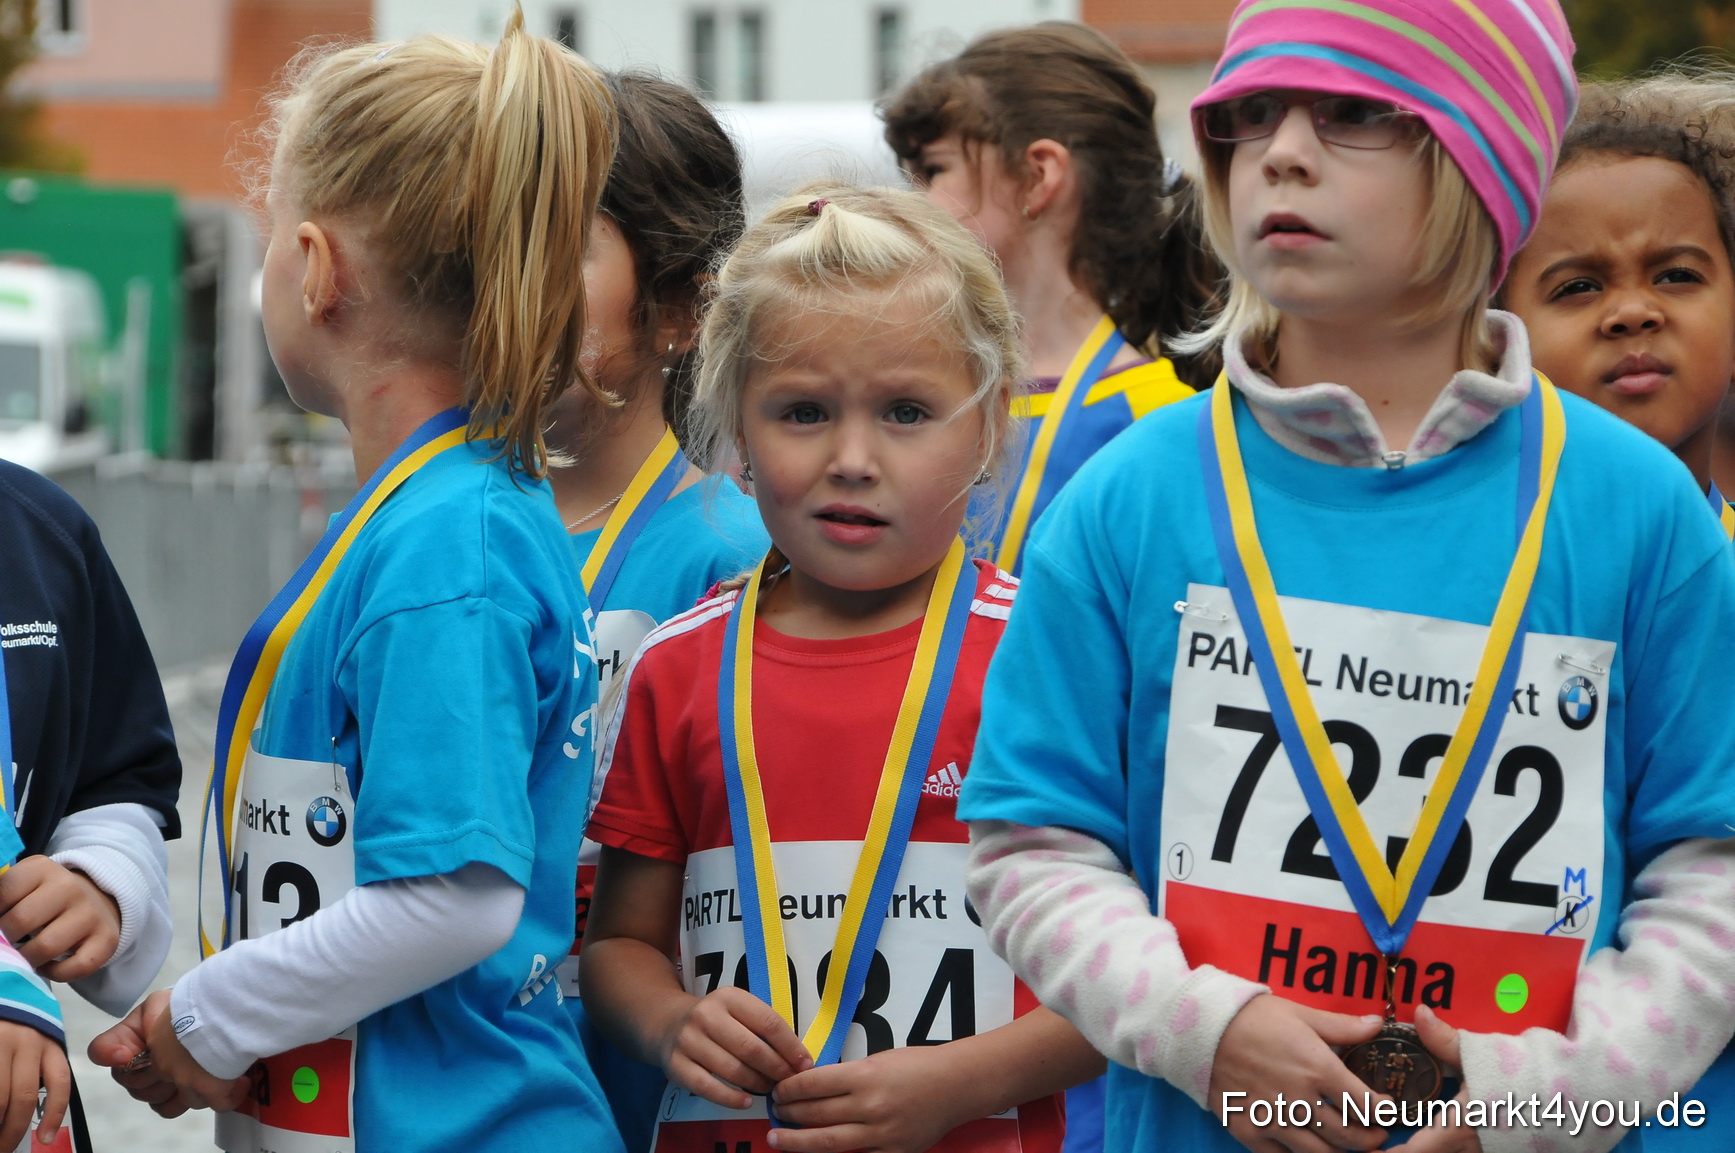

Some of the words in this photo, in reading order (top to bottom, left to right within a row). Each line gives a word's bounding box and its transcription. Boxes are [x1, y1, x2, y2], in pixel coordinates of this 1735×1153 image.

[0, 621, 57, 636] olksschule
[1188, 632, 1322, 686] PAL
[1336, 654, 1540, 716] Neumkt
[1563, 676, 1599, 698] BMW
[310, 797, 343, 816] BMW
[1211, 704, 1564, 909] 7232
[1564, 866, 1586, 896] M
[1259, 923, 1455, 1010] Hanna
